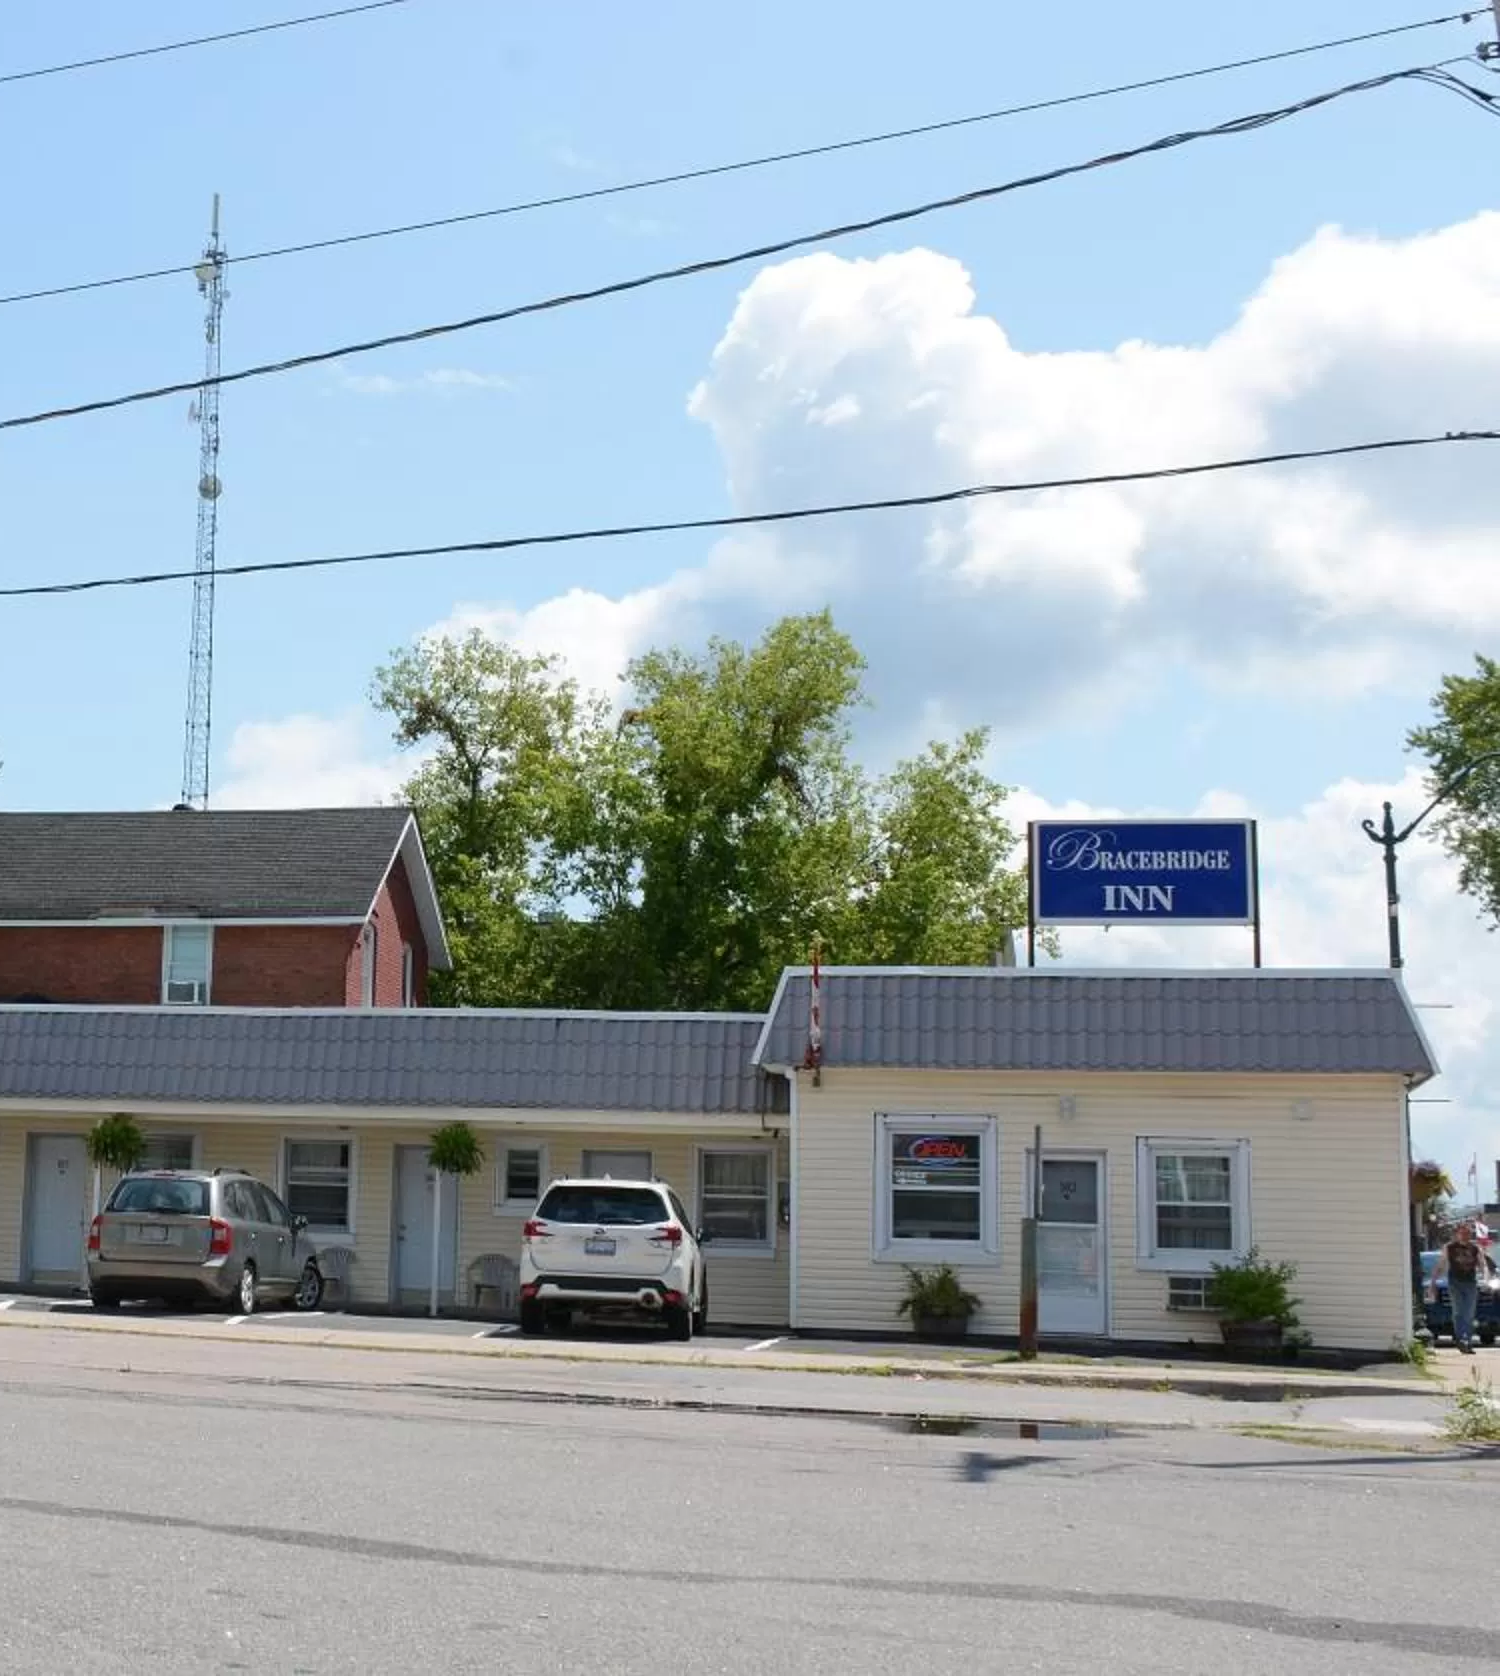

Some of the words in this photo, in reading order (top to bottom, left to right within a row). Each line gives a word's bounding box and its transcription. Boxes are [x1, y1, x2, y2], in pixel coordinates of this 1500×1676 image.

[1047, 829, 1230, 871] BRACEBRIDGE
[1103, 885, 1176, 911] INN
[915, 1142, 965, 1158] OPEN
